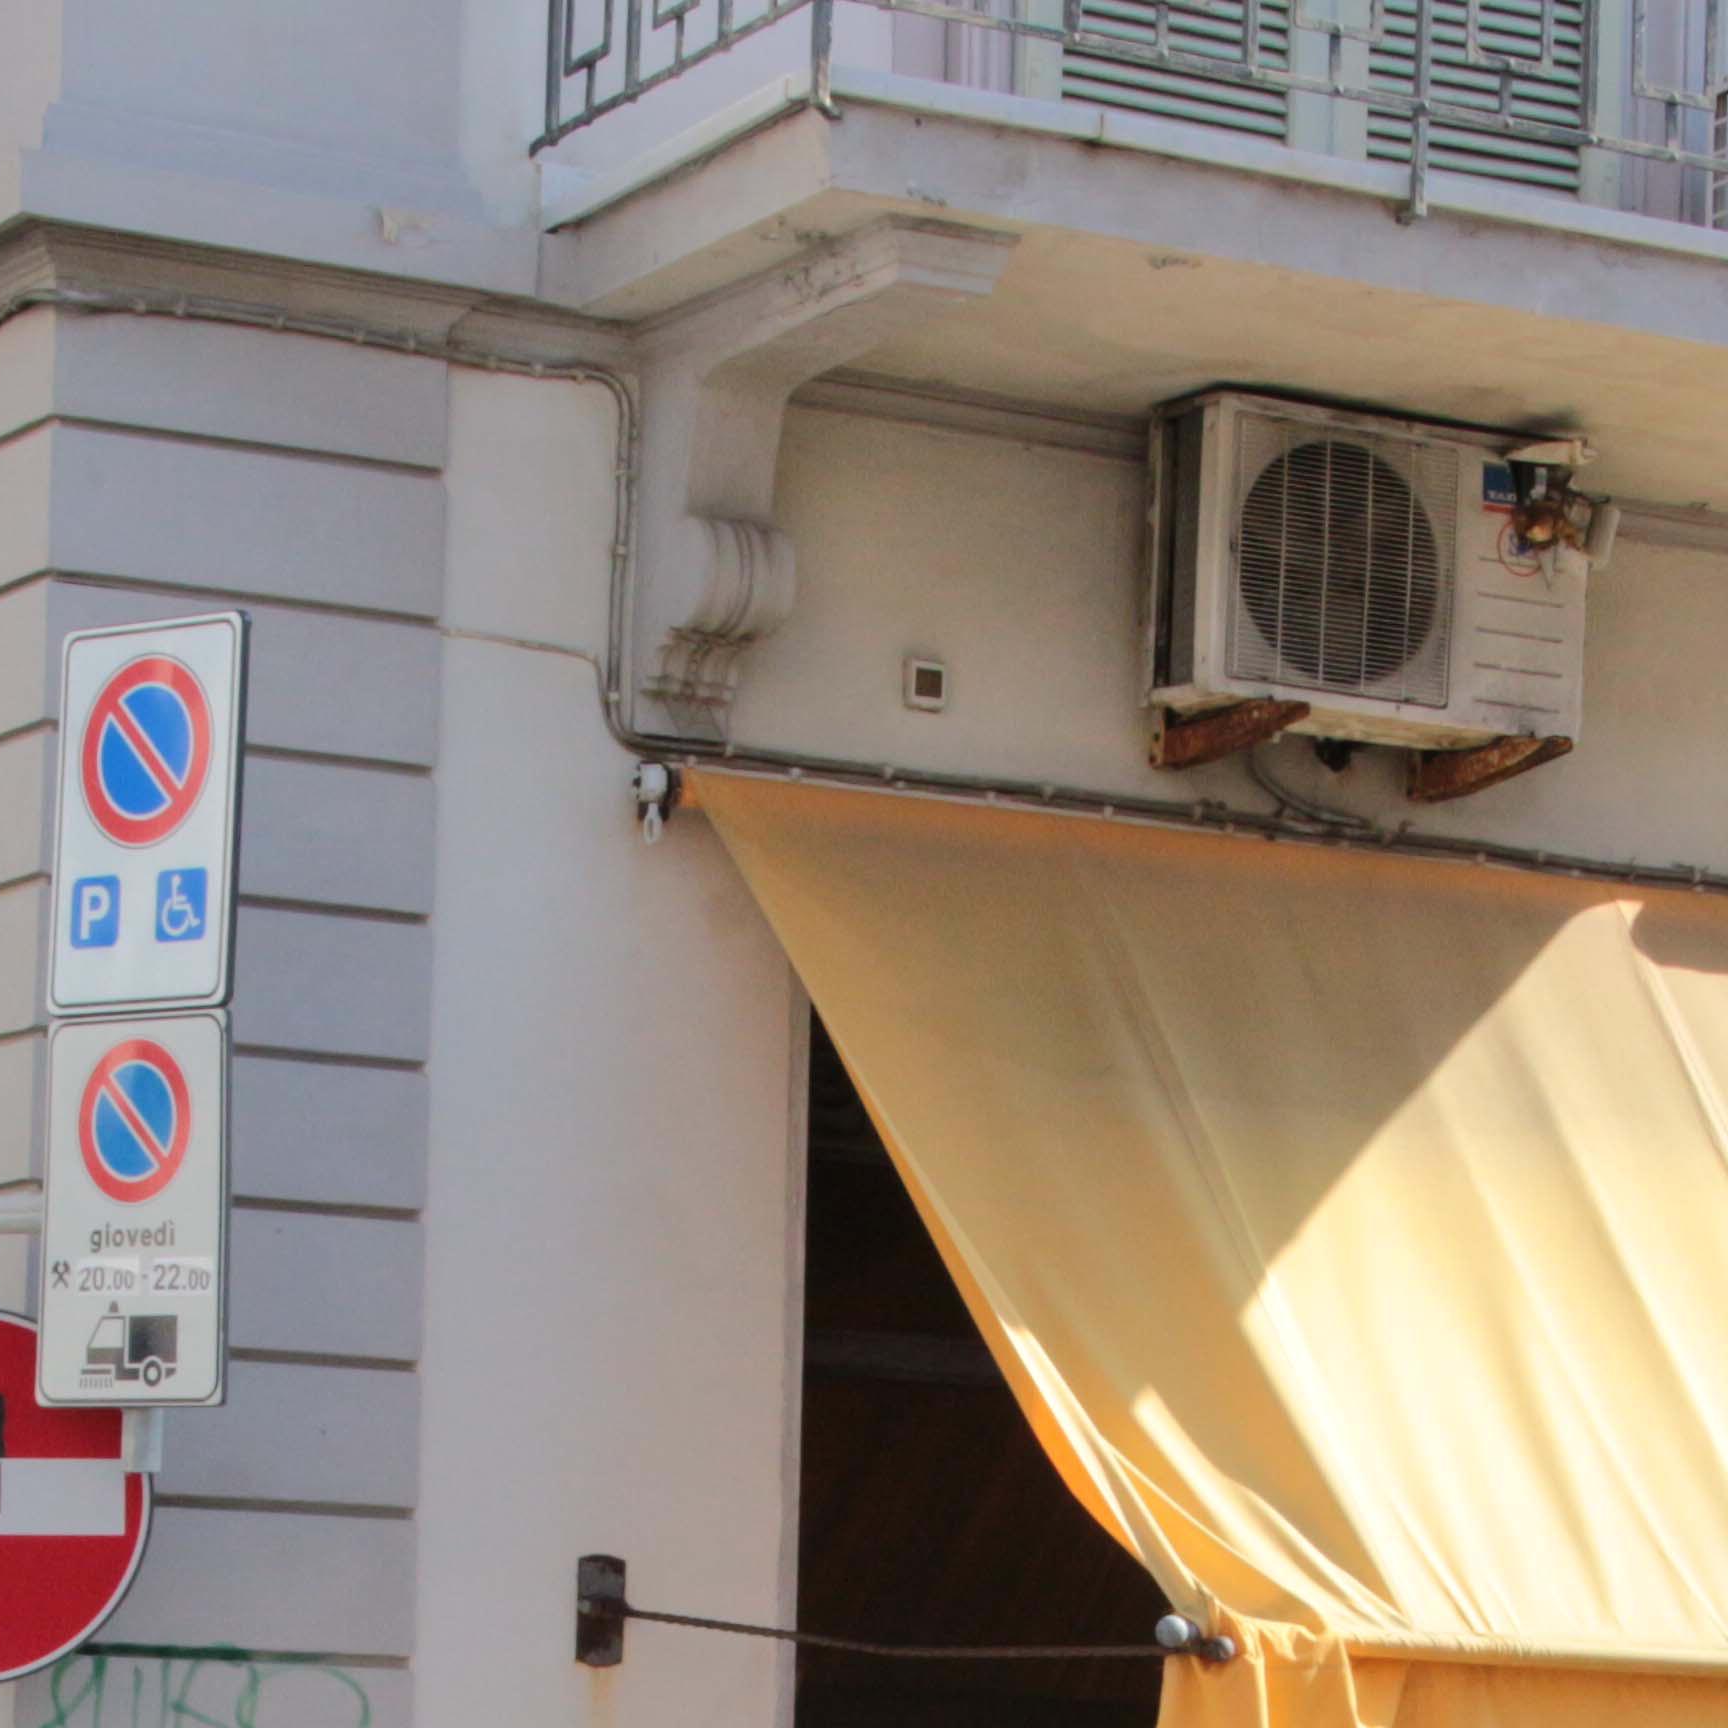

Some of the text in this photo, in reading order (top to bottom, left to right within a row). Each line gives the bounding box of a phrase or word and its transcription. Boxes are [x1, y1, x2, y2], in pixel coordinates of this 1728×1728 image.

[81, 885, 111, 940] P
[90, 1219, 175, 1253] giovedì
[79, 1267, 135, 1292] 20.00
[154, 1264, 211, 1290] 22.00
